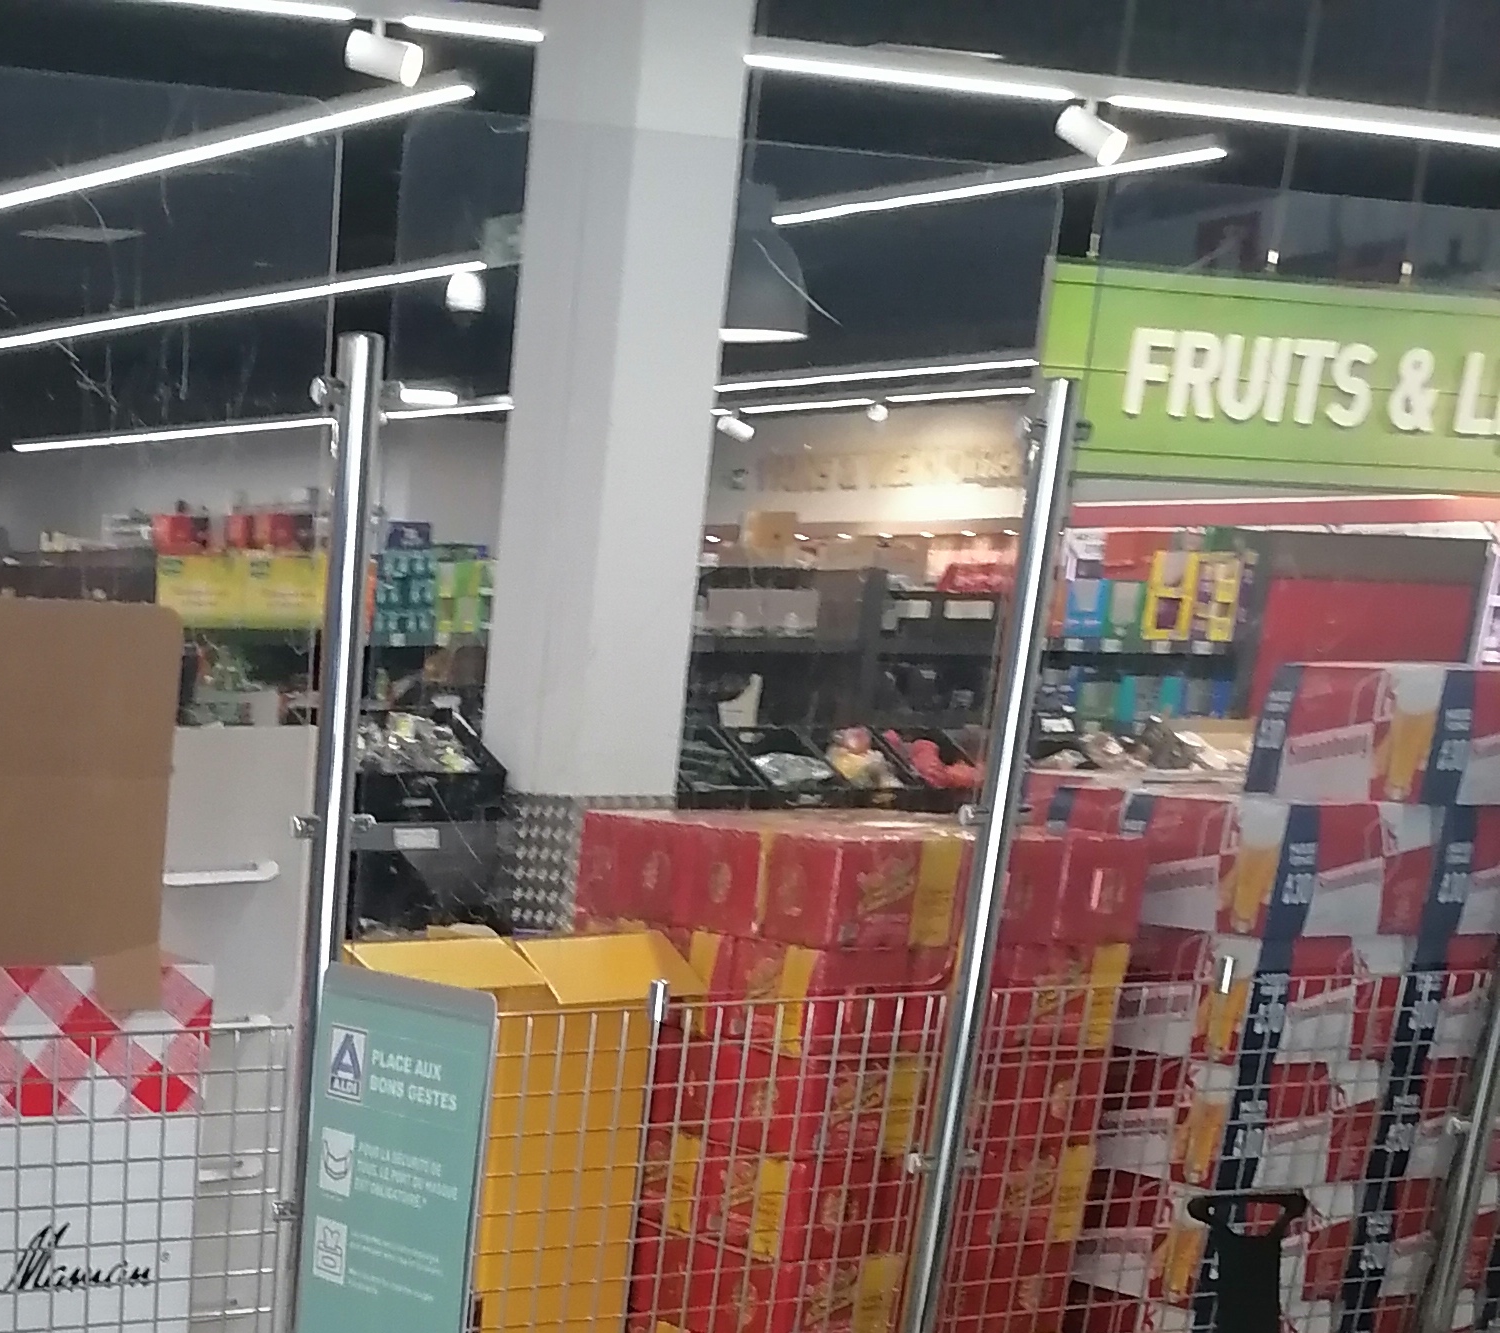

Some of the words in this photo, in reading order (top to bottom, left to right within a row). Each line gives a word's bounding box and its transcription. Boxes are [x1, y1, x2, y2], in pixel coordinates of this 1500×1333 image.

[1121, 326, 1379, 429] FRUITS
[1386, 347, 1440, 433] &
[1453, 351, 1500, 436] L
[371, 1048, 413, 1075] PLACE
[414, 1058, 443, 1082] AUX
[332, 1079, 358, 1096] ALDI
[369, 1075, 406, 1098] BONS
[408, 1084, 459, 1112] GESTES
